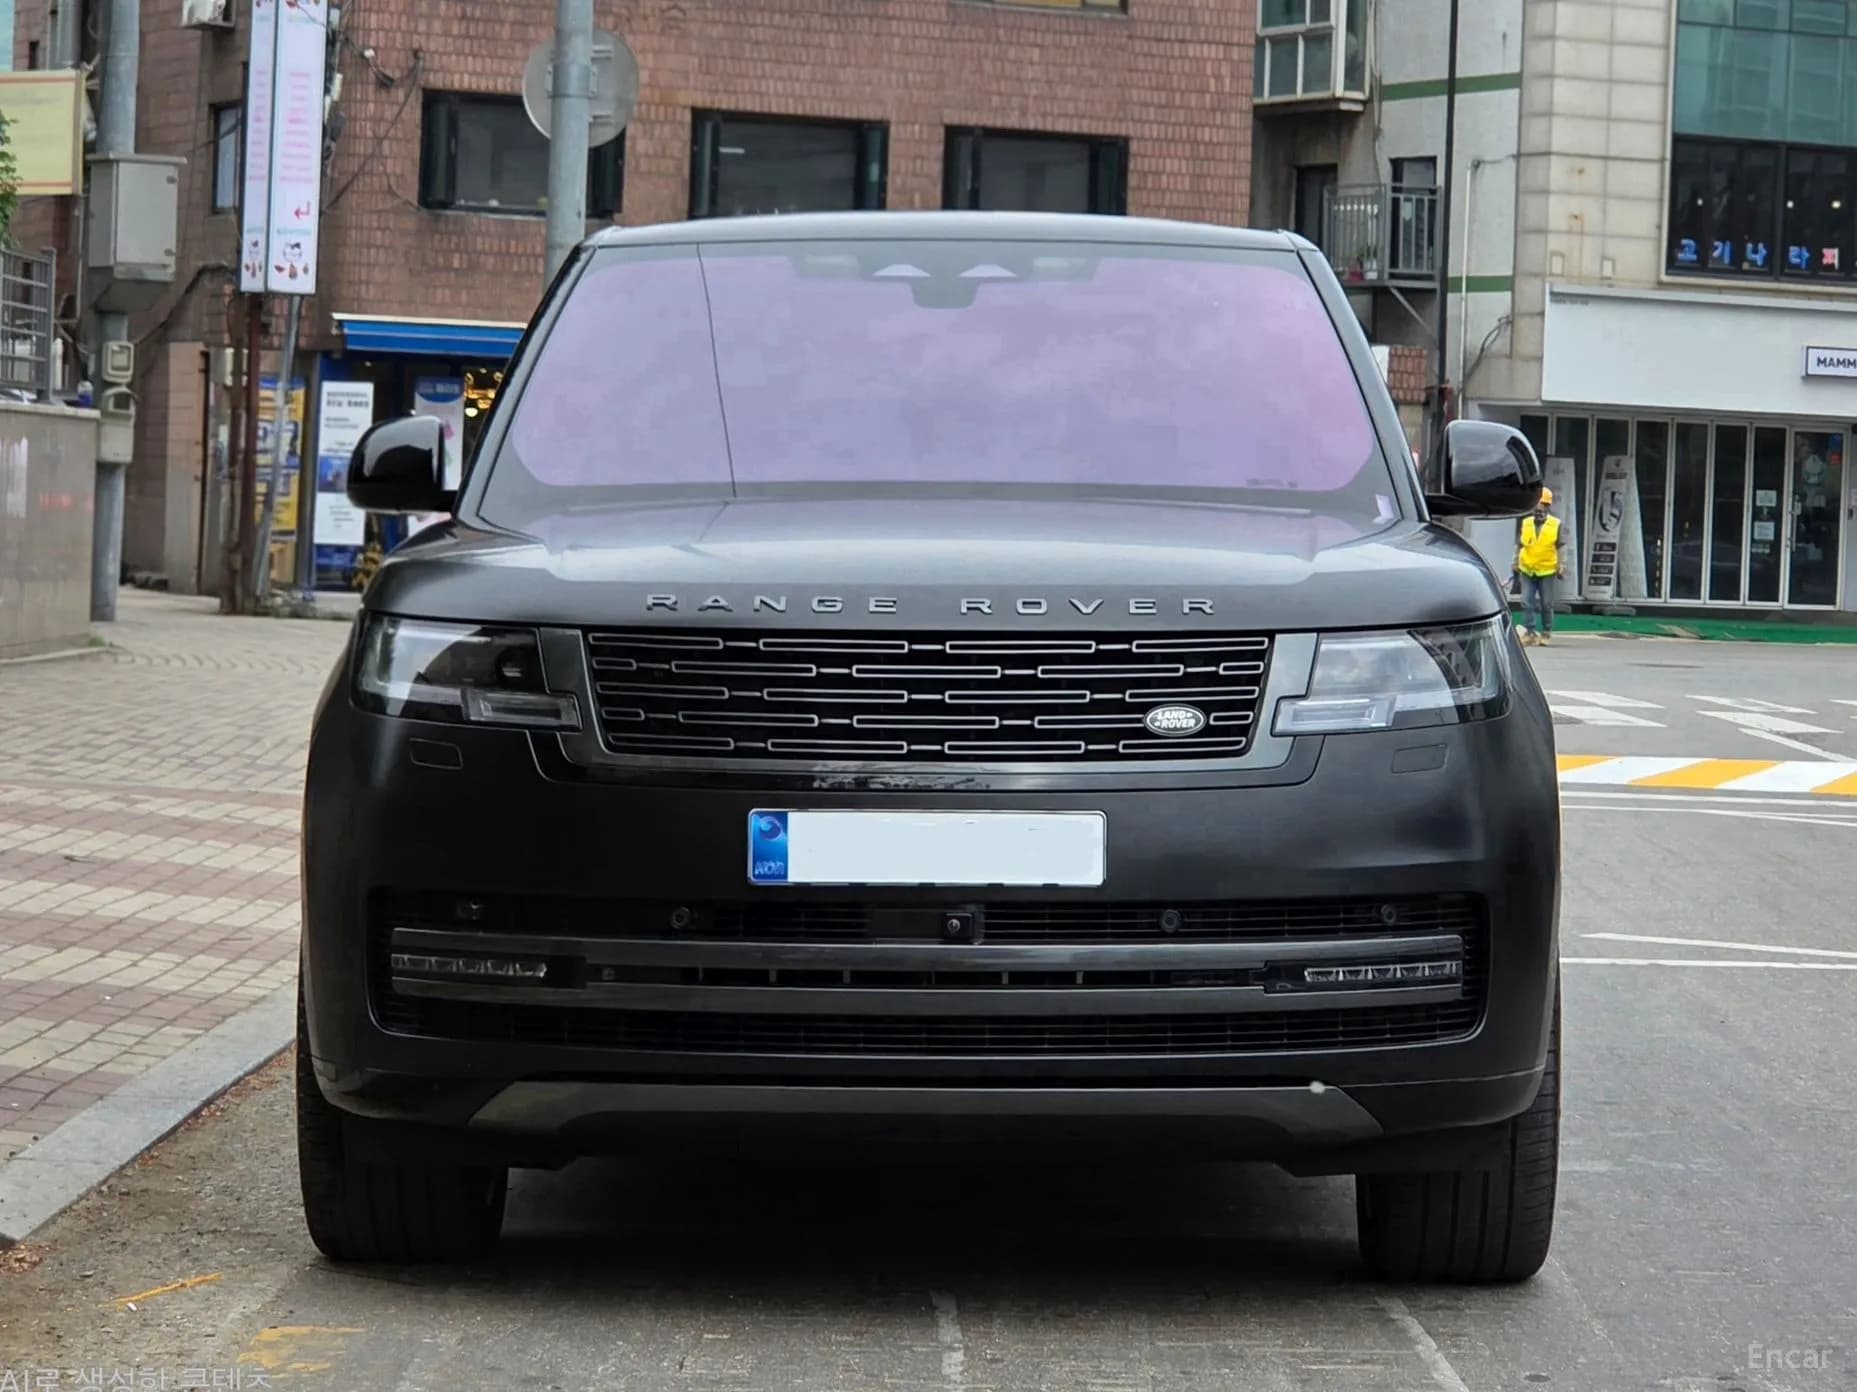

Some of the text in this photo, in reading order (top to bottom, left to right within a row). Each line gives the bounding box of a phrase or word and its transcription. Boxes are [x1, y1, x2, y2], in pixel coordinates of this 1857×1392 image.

[1816, 356, 1857, 369] MAMM
[646, 594, 1215, 615] RANGE ROVER
[1157, 710, 1186, 720] LAND
[1160, 719, 1196, 729] ROVER
